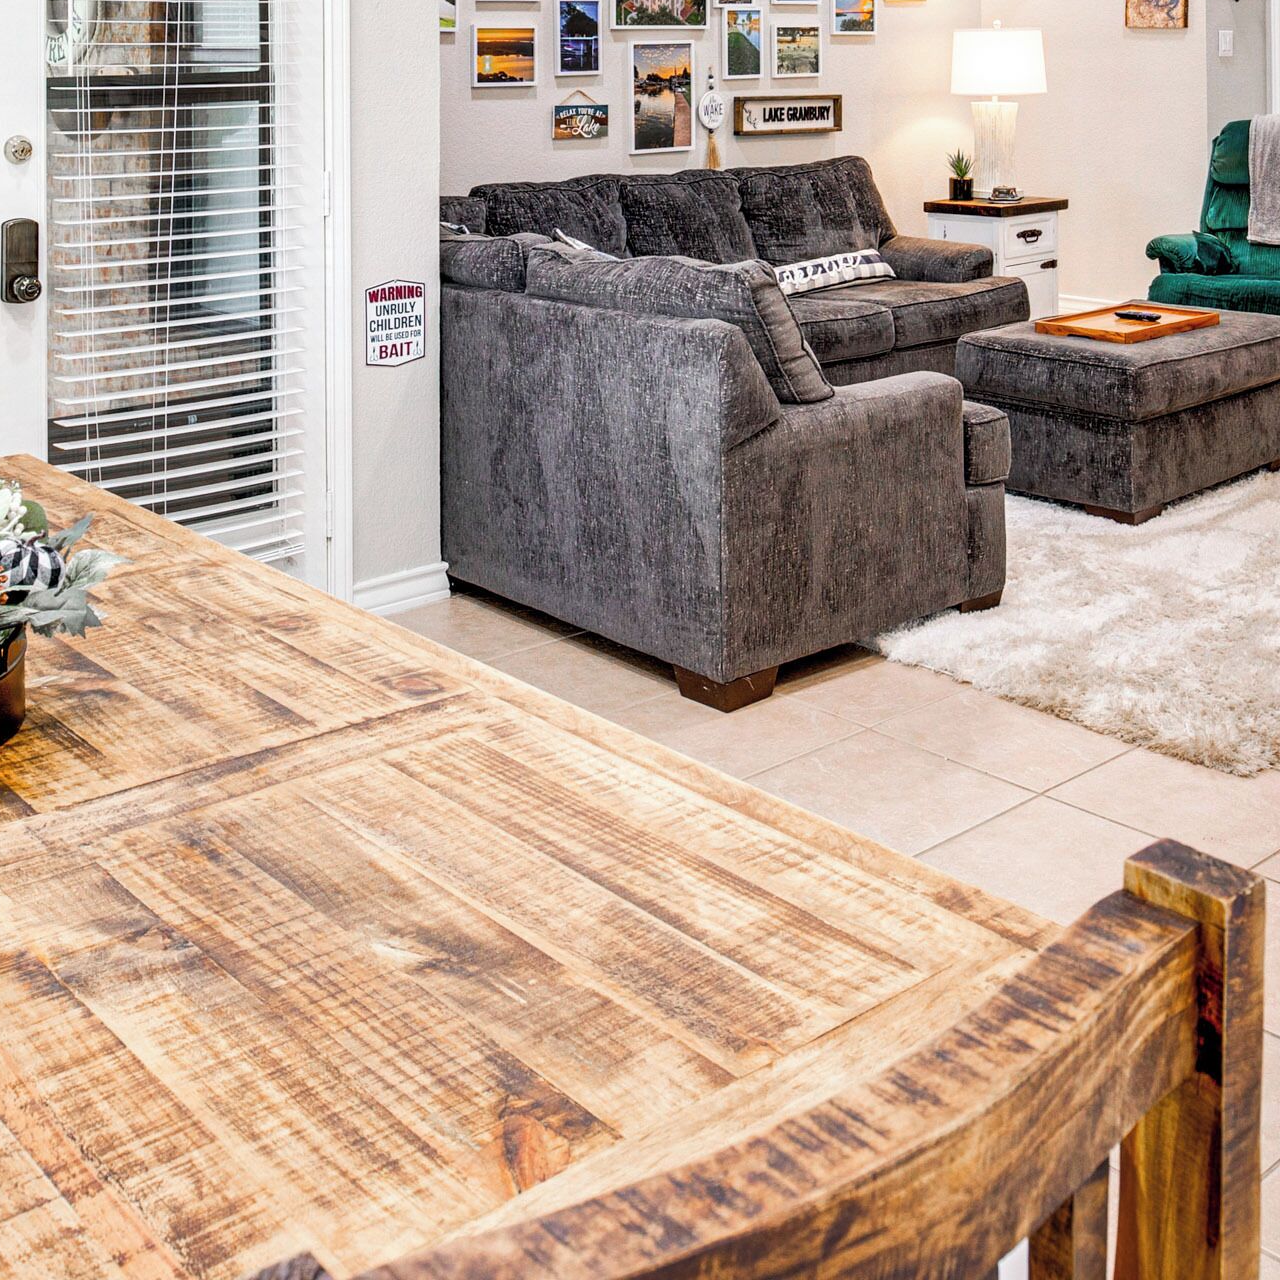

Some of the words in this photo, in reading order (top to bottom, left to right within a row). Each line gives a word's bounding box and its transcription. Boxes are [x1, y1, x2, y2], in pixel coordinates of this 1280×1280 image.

[559, 108, 577, 119] RELAX
[703, 102, 723, 116] WAKE
[763, 107, 785, 122] LAKE
[786, 106, 831, 121] GRANBURY
[571, 114, 600, 138] Lake
[368, 285, 423, 303] WARNING
[375, 301, 416, 317] UNRULY
[369, 314, 422, 333] CHILDREN
[370, 334, 384, 343] WILL
[385, 333, 393, 341] BE
[394, 330, 409, 340] USED
[410, 329, 422, 338] FOR
[379, 341, 413, 360] BAIT
